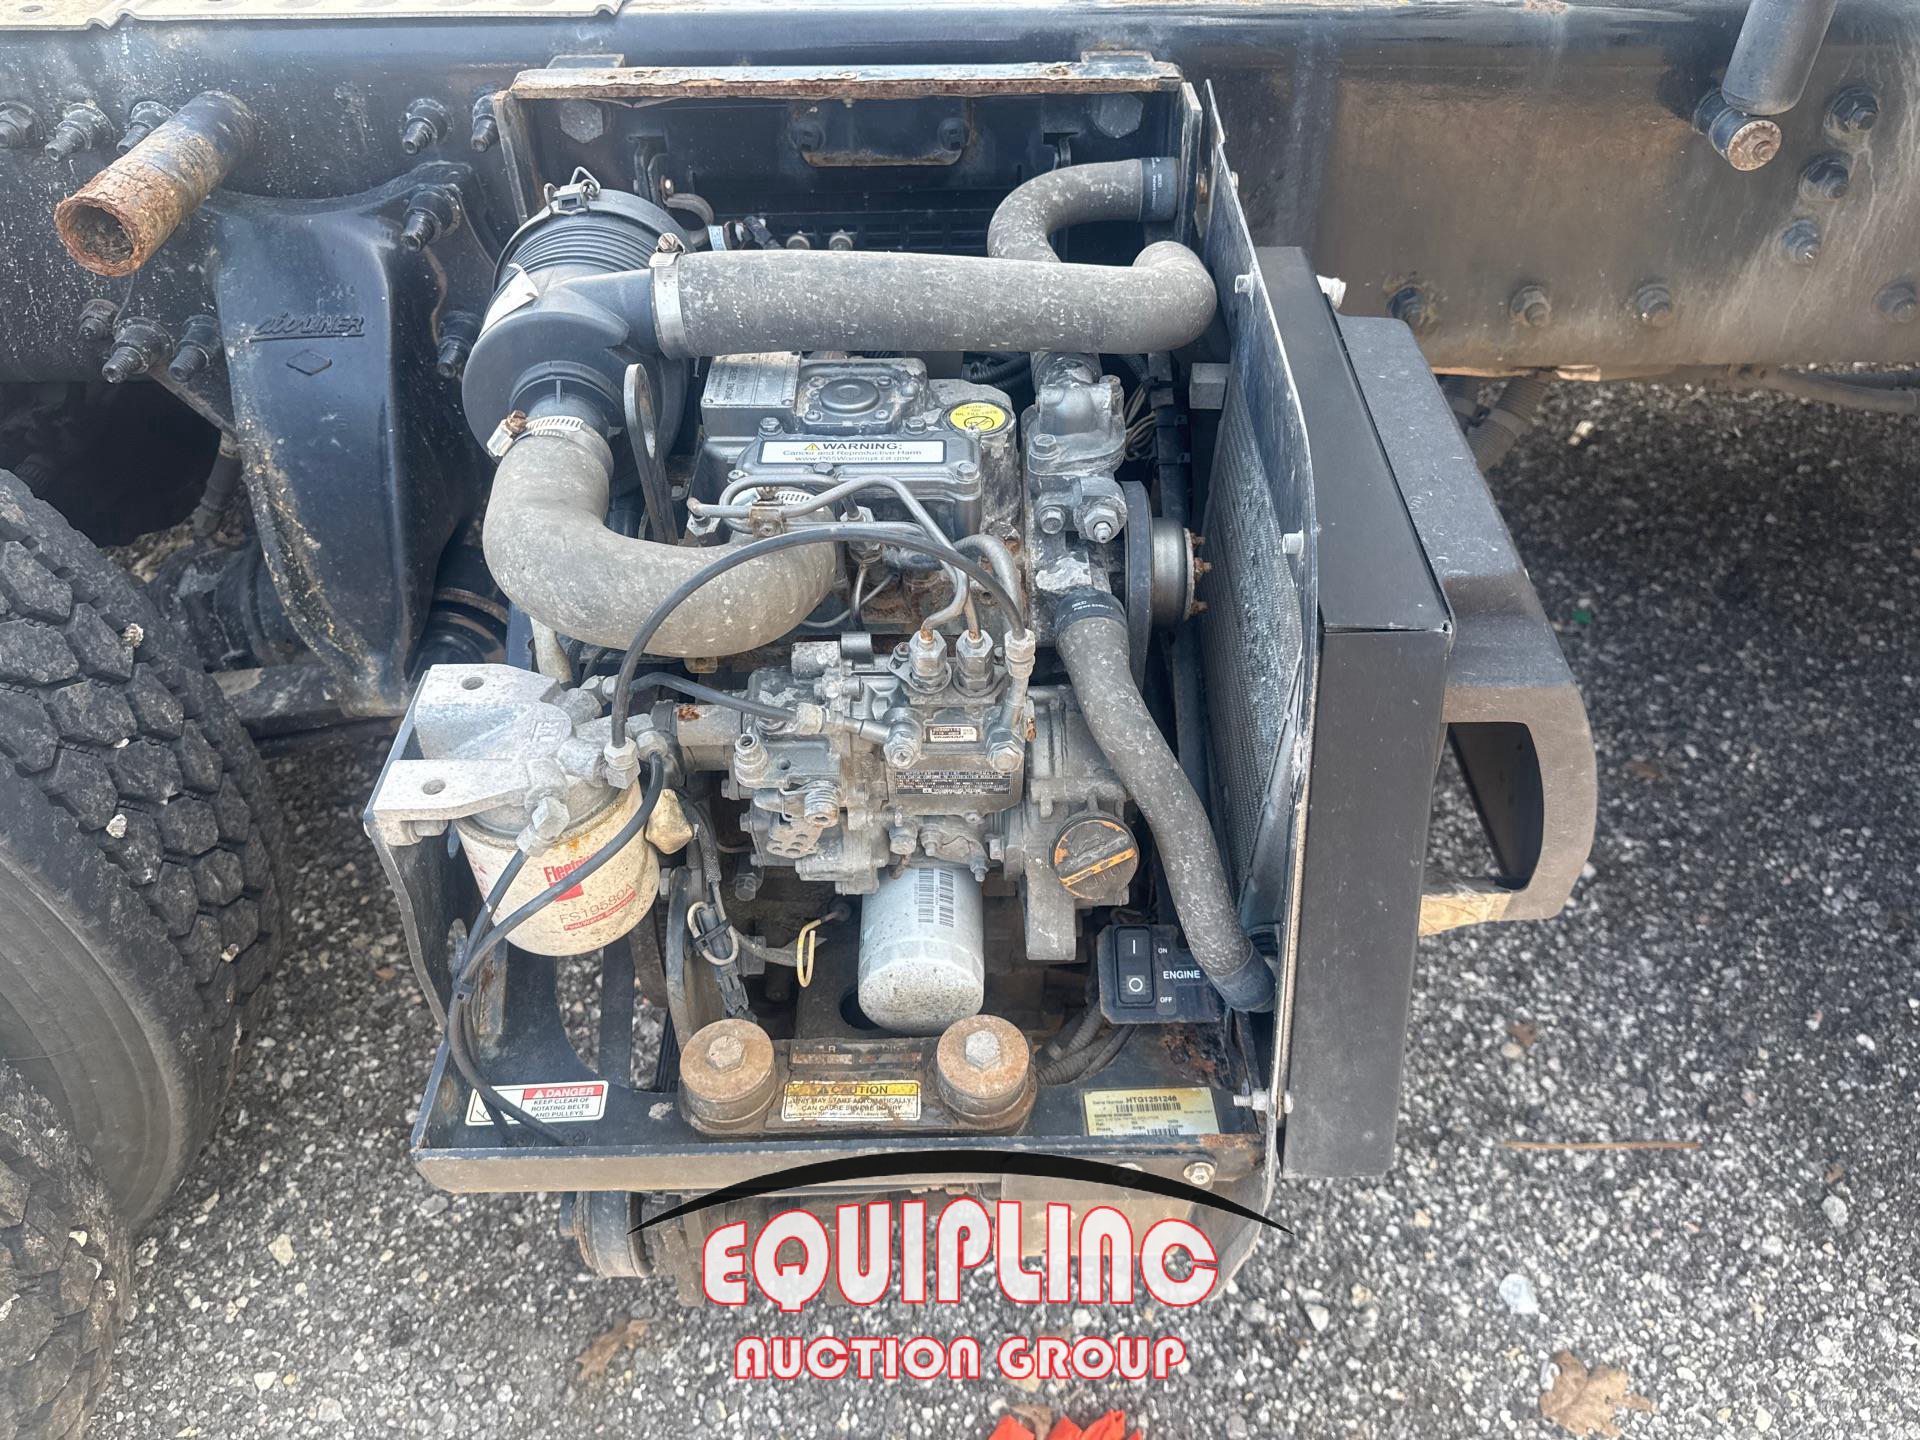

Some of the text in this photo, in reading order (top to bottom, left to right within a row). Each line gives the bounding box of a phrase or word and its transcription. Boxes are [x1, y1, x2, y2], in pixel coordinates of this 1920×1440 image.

[559, 883, 633, 924] FS19580A
[1163, 970, 1201, 980] ENGINE
[545, 1087, 595, 1097] DANGER
[831, 1086, 888, 1095] CAUTION
